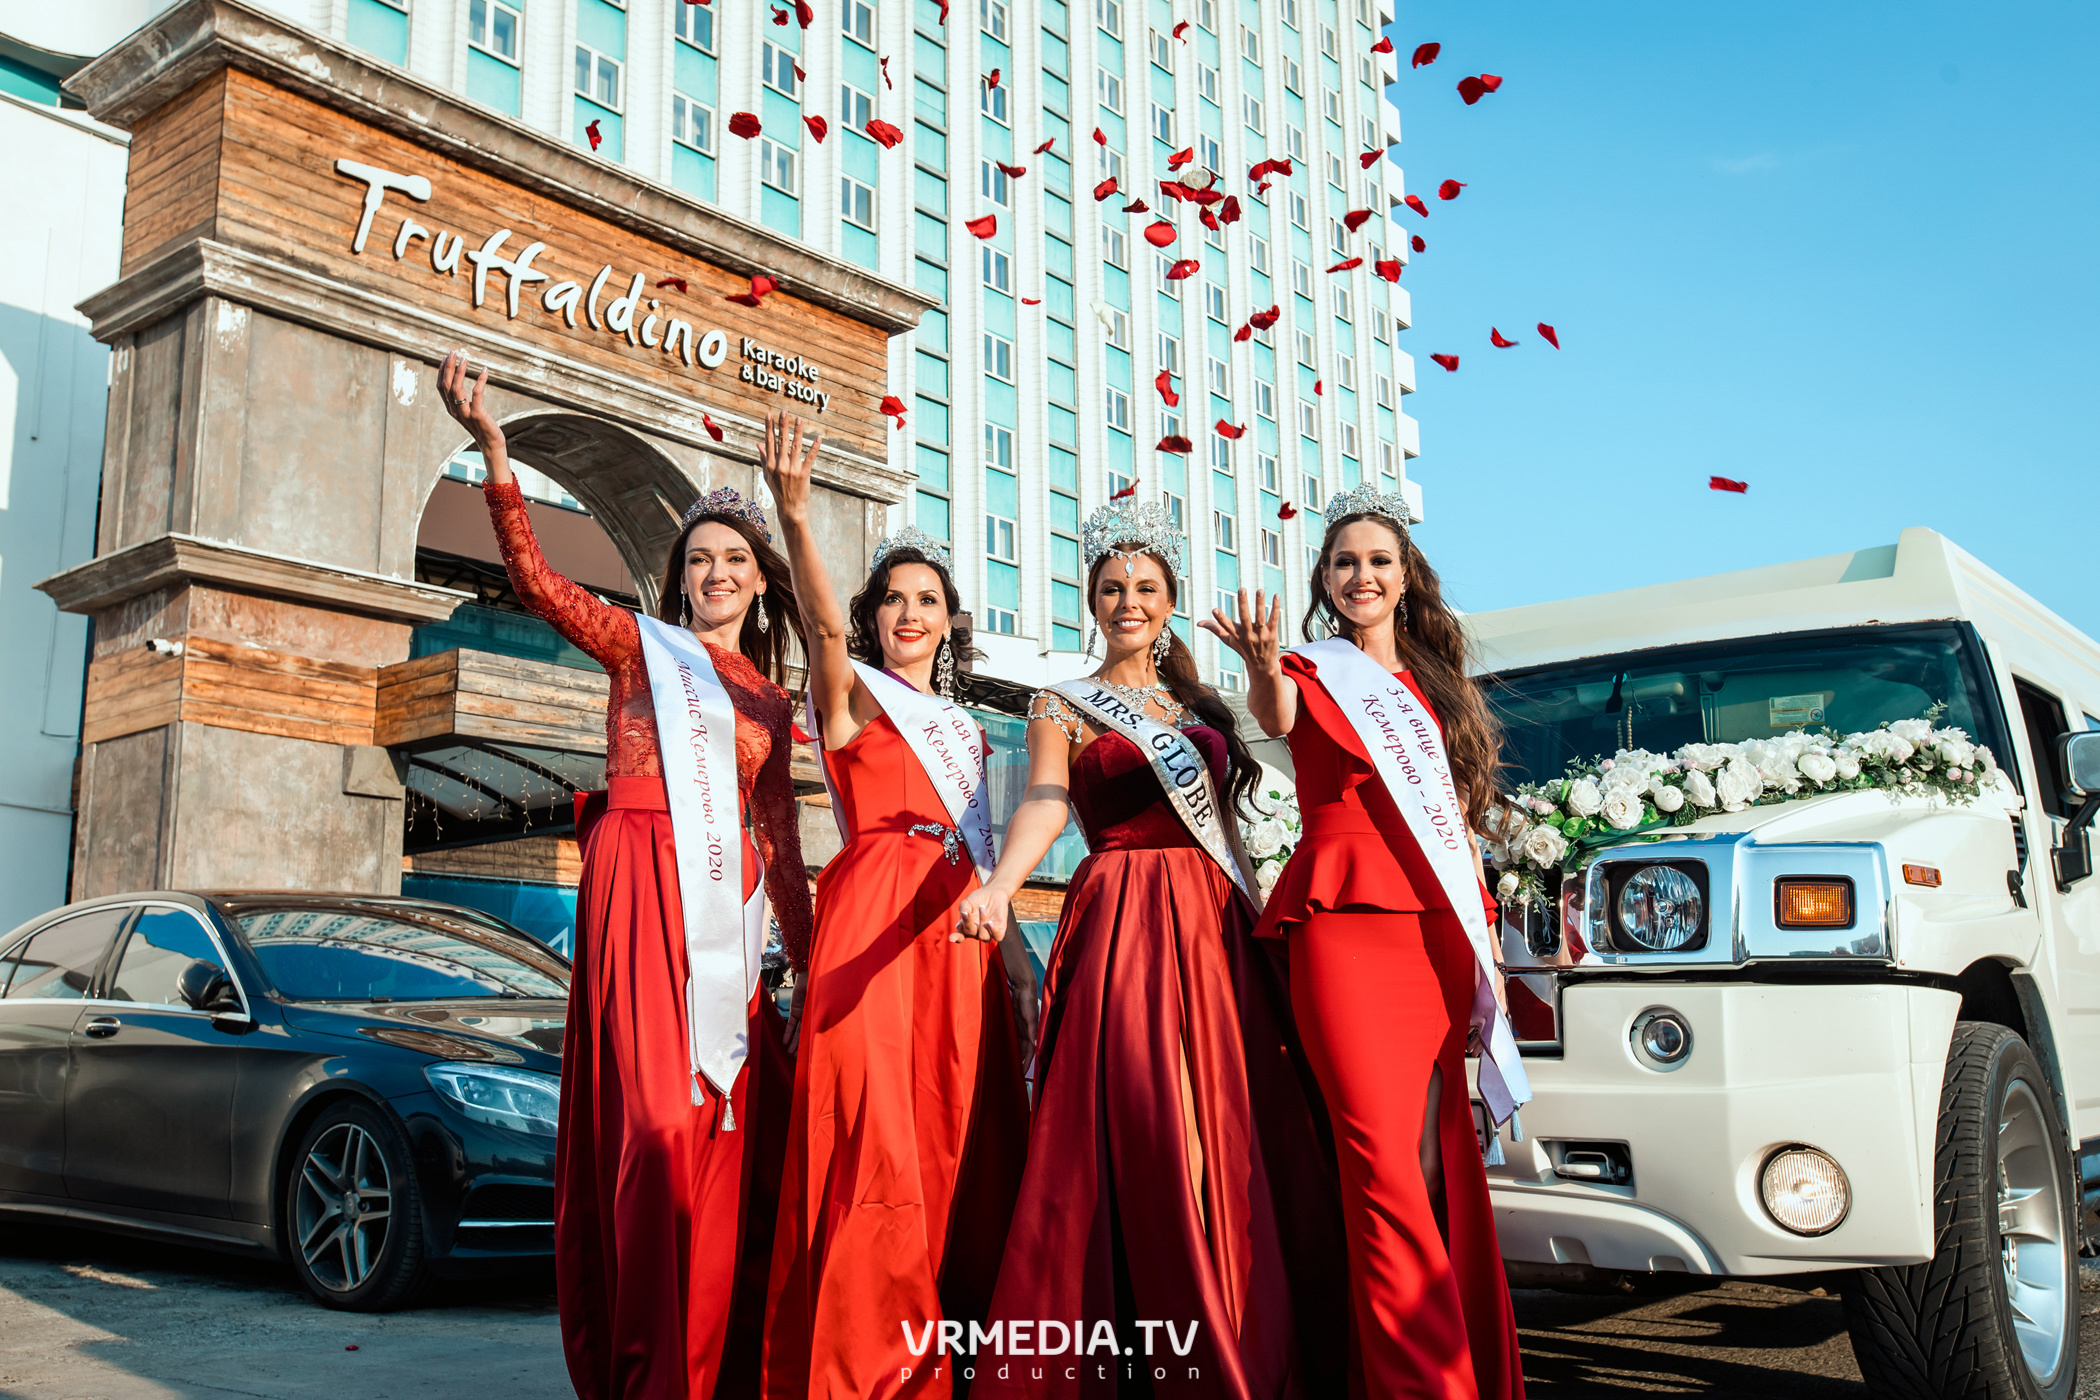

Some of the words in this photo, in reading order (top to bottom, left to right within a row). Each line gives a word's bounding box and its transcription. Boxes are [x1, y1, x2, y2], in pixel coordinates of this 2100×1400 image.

[336, 158, 728, 369] Truffaldino
[742, 337, 819, 381] Karaoke
[742, 364, 755, 382] &
[756, 363, 786, 391] bar
[786, 380, 831, 411] story
[673, 656, 702, 720] Миссис
[689, 723, 715, 825] Кемерово
[706, 831, 723, 882] 2020
[921, 720, 979, 809] Кемерово
[1080, 688, 1144, 730] MRS.
[1151, 732, 1215, 828] GLOBE
[1360, 693, 1422, 785] Кемерово
[1422, 803, 1459, 850] 2020
[1386, 686, 1414, 715] 3-я
[1409, 718, 1440, 761] вице
